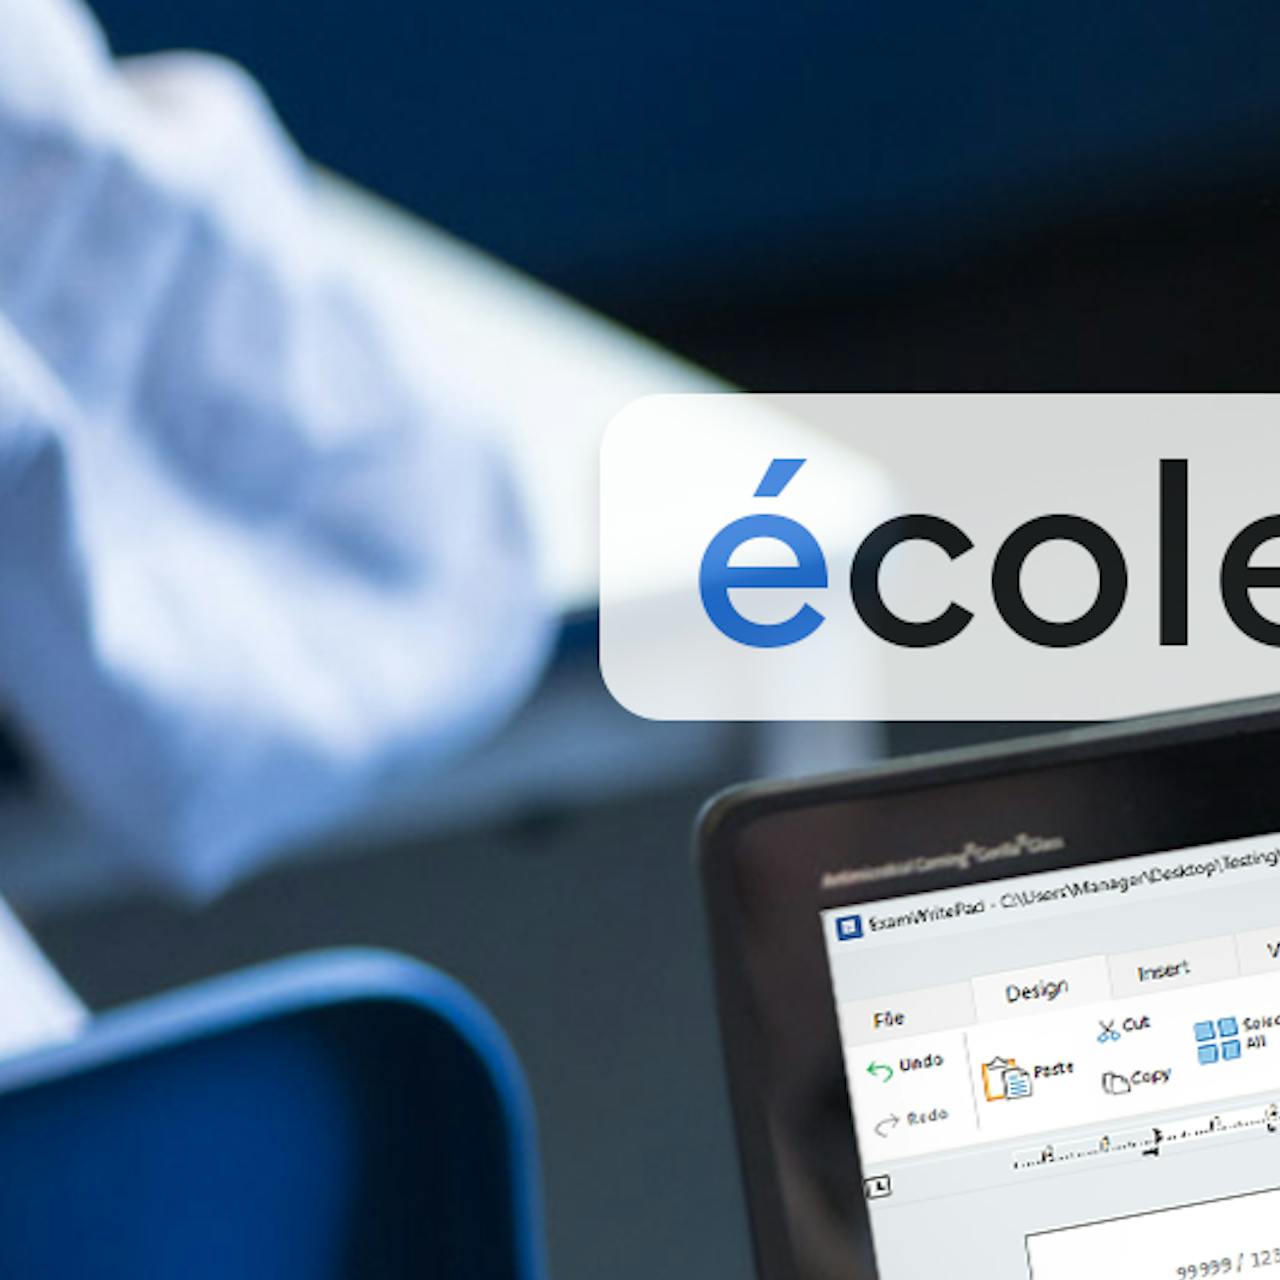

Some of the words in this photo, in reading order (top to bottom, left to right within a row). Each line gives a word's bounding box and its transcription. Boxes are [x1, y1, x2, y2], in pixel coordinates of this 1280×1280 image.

[868, 899, 986, 933] ExamWritePad
[1137, 959, 1191, 983] Insert
[1005, 979, 1070, 1004] Design
[873, 1010, 906, 1029] File
[1121, 1015, 1152, 1033] Cut
[1246, 1034, 1267, 1049] All
[899, 1053, 945, 1073] Undo
[1033, 1061, 1075, 1079] Paste
[1129, 1067, 1173, 1092] Copy
[906, 1108, 949, 1126] Redo
